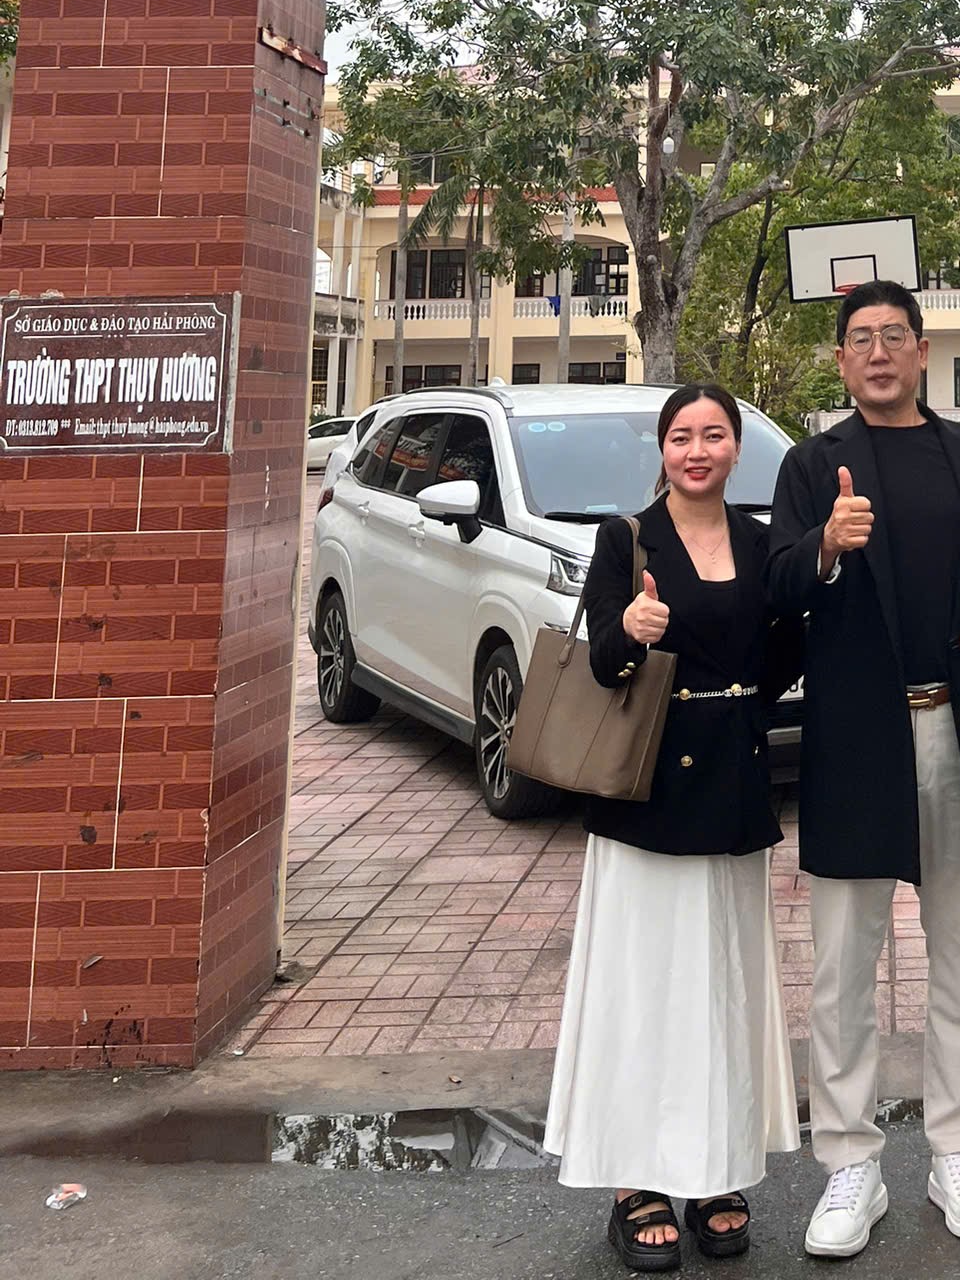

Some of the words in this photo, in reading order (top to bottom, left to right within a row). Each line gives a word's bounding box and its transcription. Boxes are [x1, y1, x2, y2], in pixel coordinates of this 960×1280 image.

[15, 314, 31, 332] SỞ
[32, 315, 61, 332] GIÁO
[63, 318, 88, 335] DỤC
[89, 317, 99, 331] &
[128, 317, 150, 333] TẠO
[152, 311, 173, 330] HẢI
[6, 347, 71, 405] TRƯỜNG
[75, 358, 115, 404] THPT
[118, 357, 159, 413] THỤY
[160, 352, 217, 402] HƯƠNG
